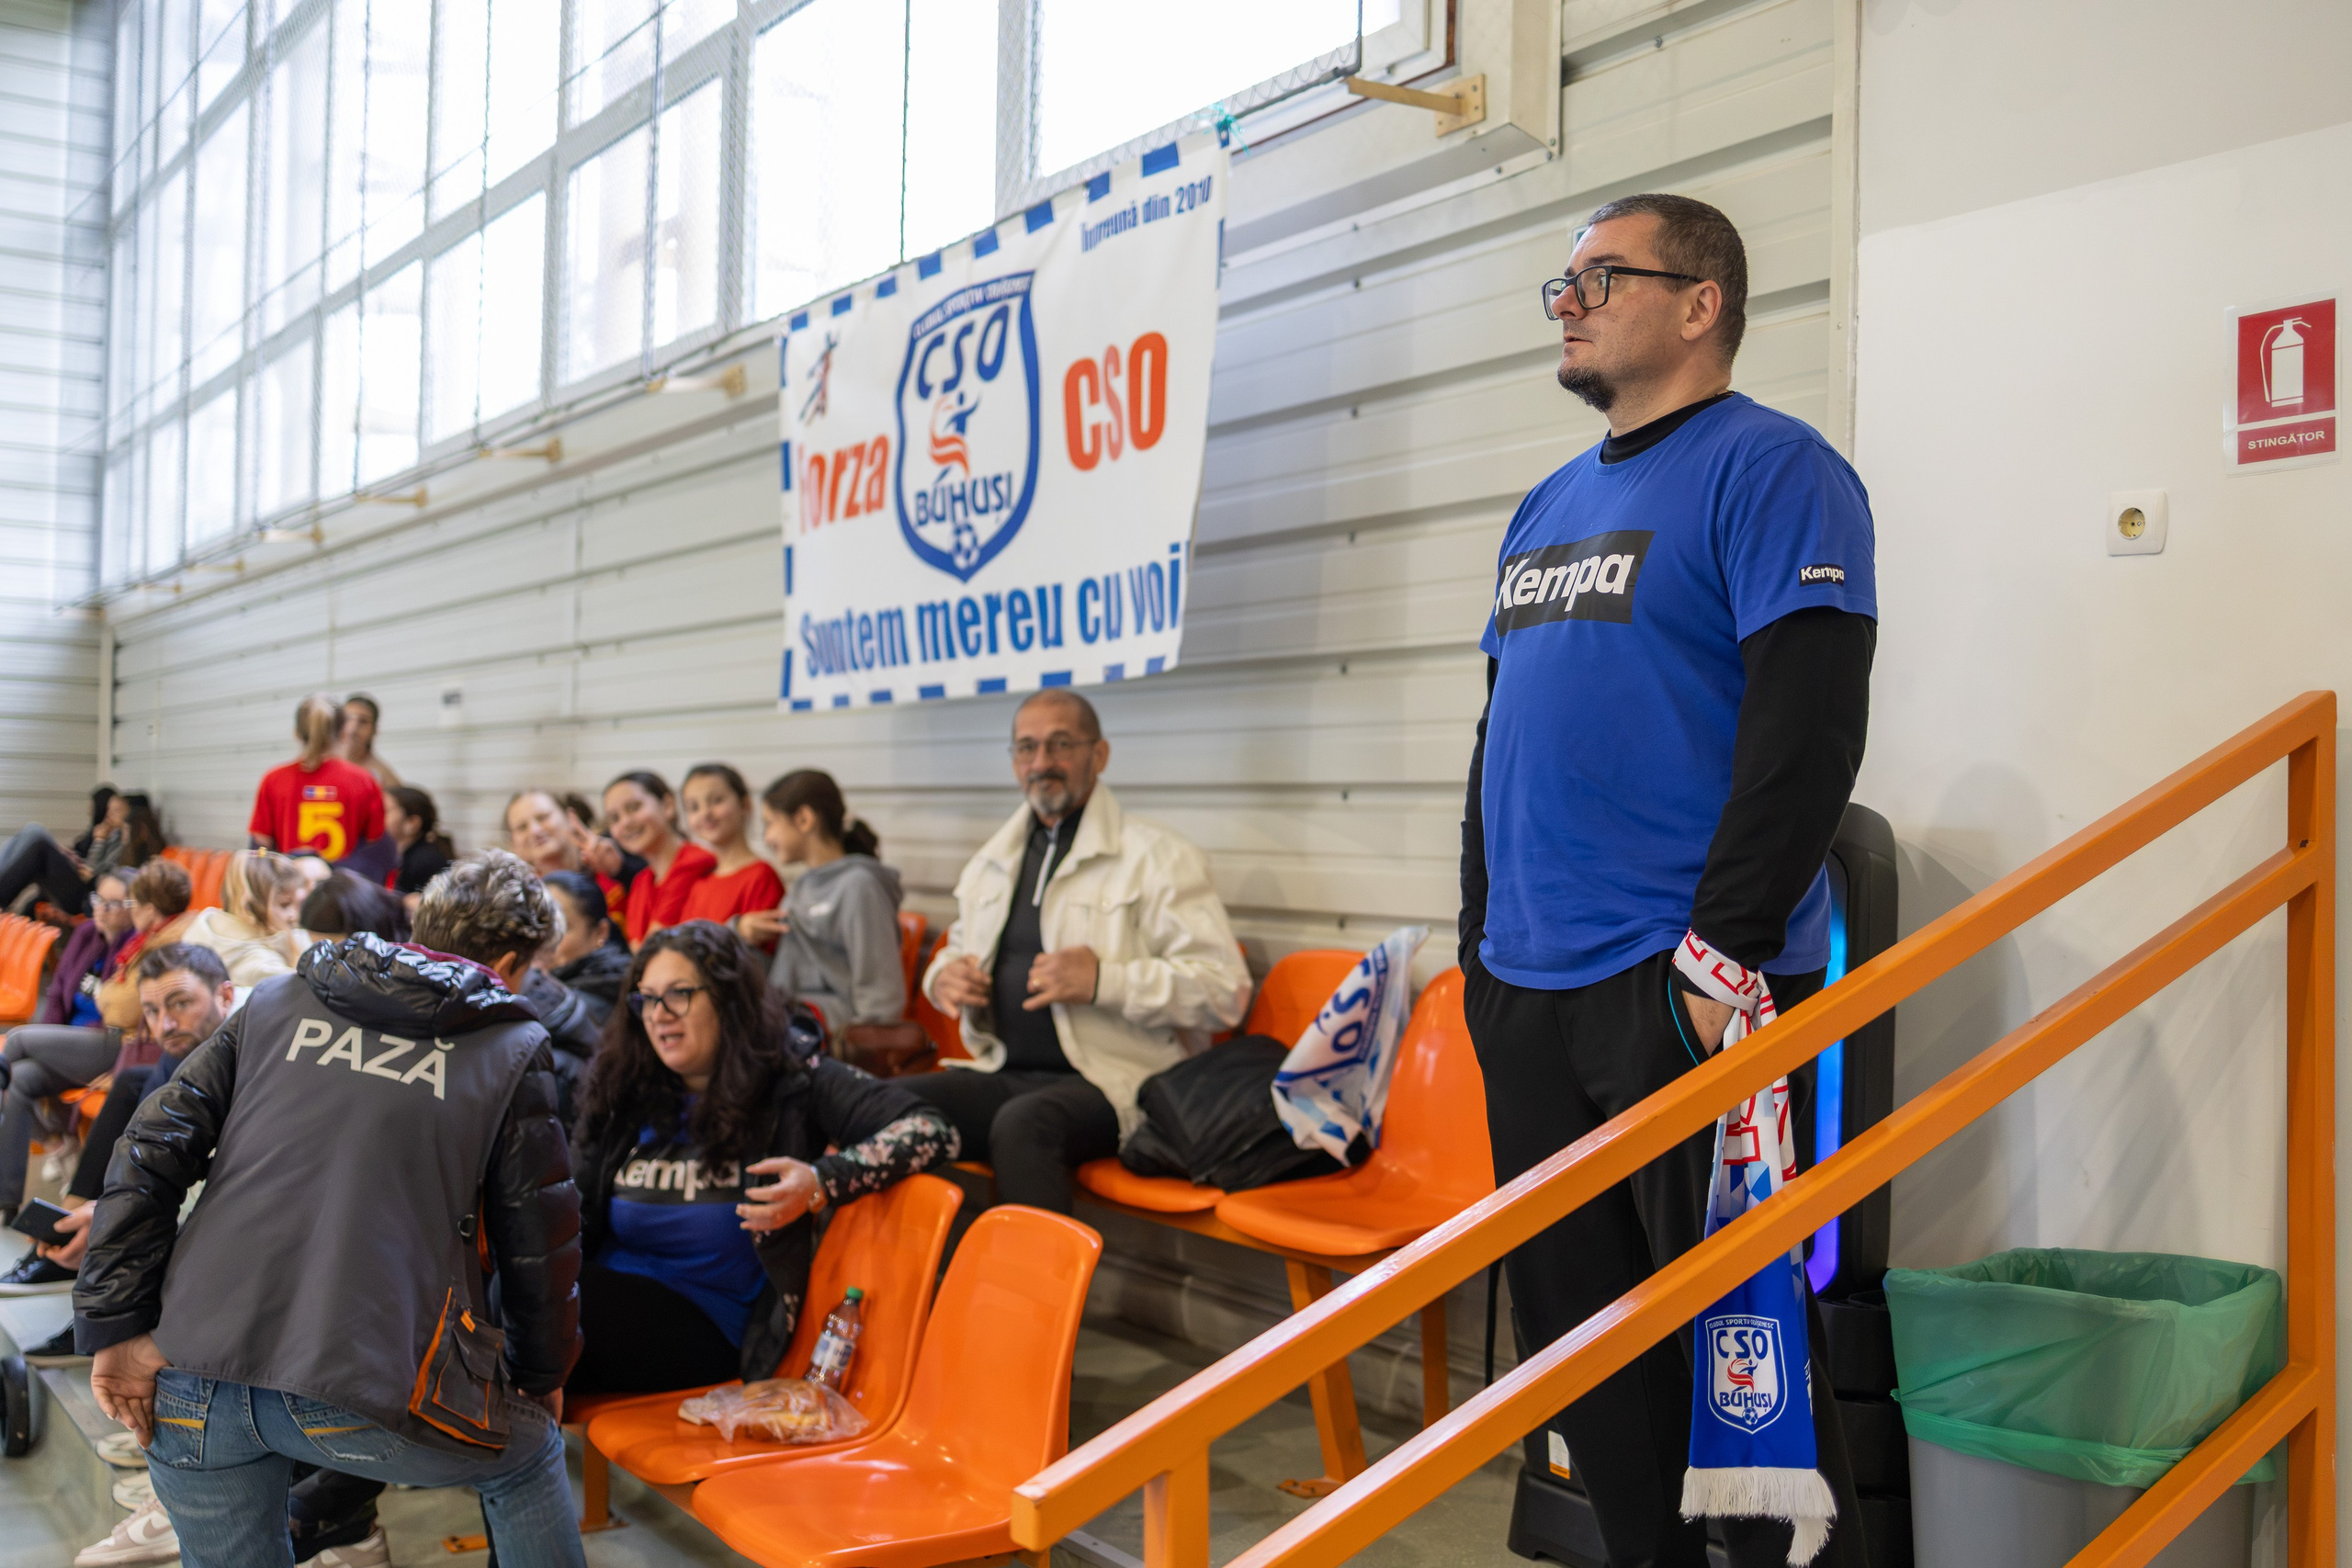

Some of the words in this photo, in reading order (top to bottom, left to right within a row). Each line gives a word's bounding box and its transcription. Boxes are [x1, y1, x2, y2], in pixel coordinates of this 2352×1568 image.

[917, 304, 1010, 400] CSO
[1062, 331, 1168, 472] CSO
[2247, 430, 2325, 450] STINGĂTOR
[1495, 553, 1635, 614] Kempa
[1800, 565, 1845, 582] Kempa
[800, 606, 910, 679] Suntem
[916, 582, 1064, 665] mereu
[1077, 576, 1123, 646] cu
[1128, 540, 1181, 637] voi
[297, 800, 346, 862] 5
[285, 1018, 456, 1100] PAZĂ
[1715, 1329, 1769, 1359] CSO
